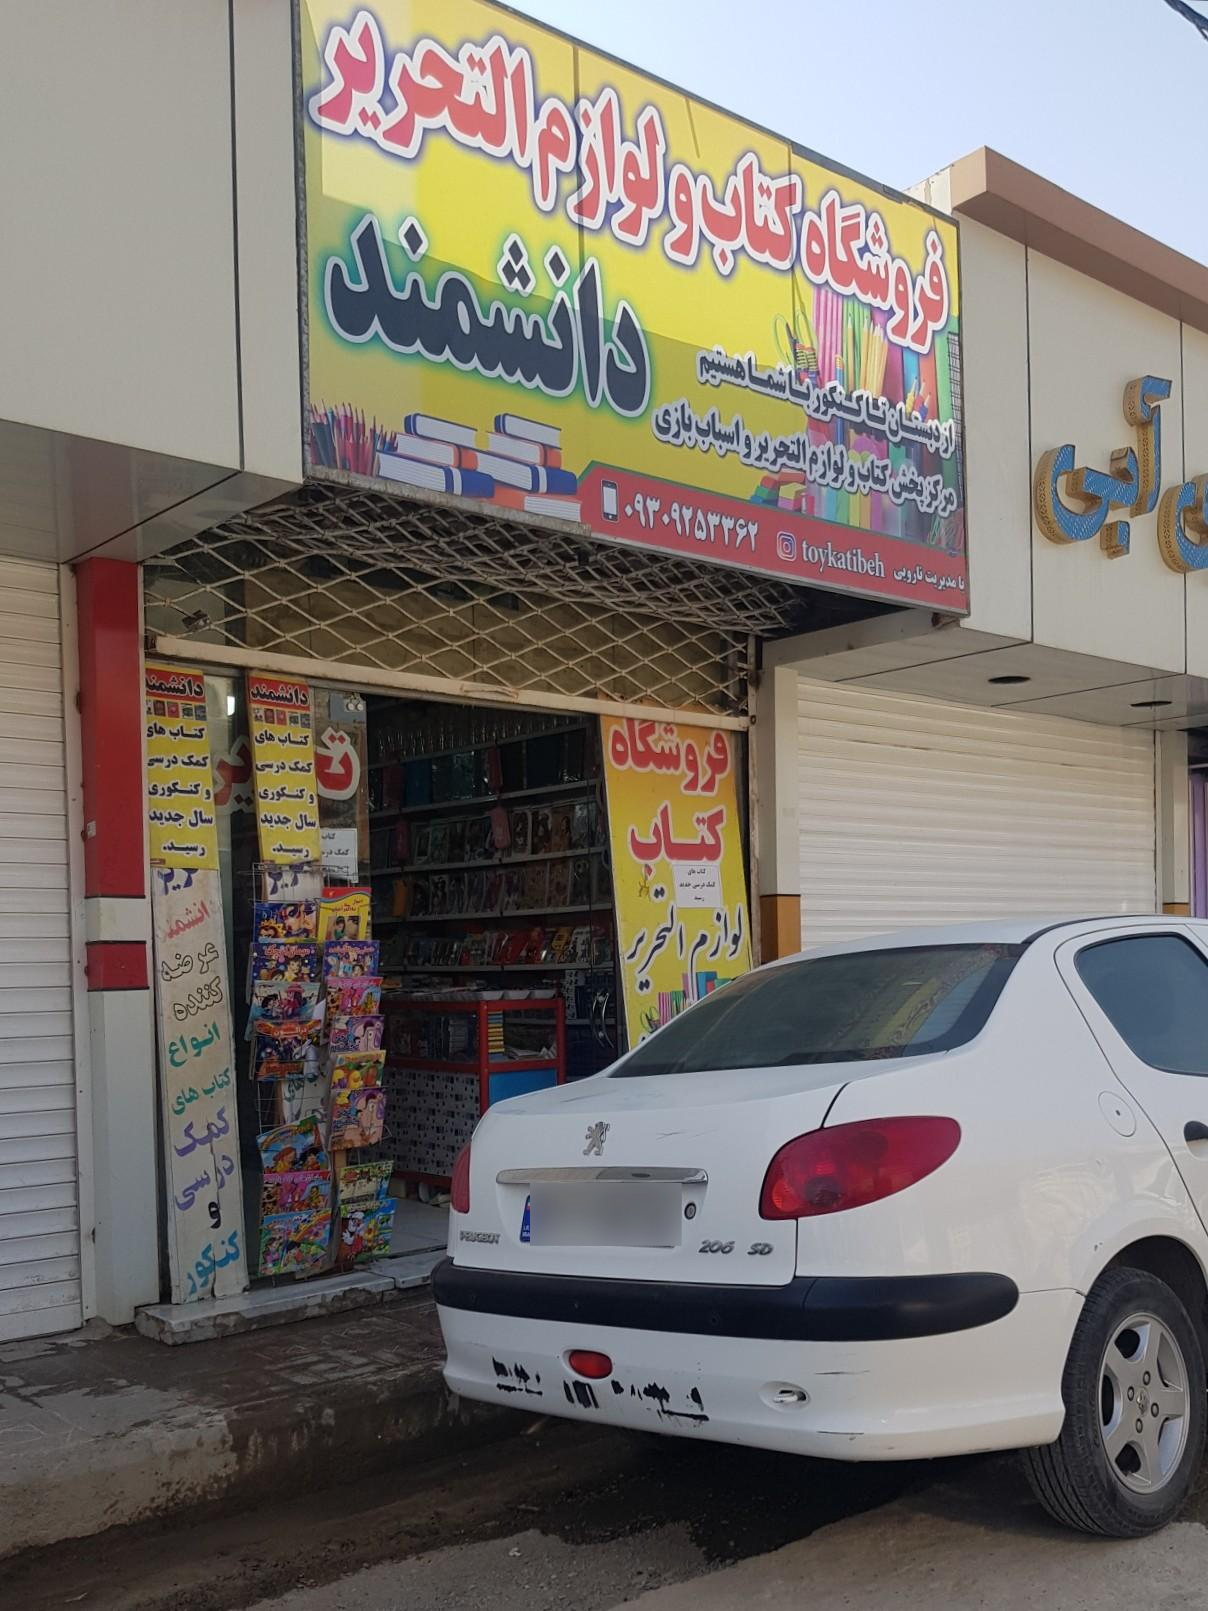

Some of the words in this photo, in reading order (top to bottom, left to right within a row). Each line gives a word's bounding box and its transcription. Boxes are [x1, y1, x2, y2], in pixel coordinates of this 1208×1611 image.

[309, 10, 531, 168] التحریر
[533, 88, 666, 246] لوازم
[664, 164, 698, 265] و
[698, 152, 801, 275] کتاب
[802, 190, 950, 354] فروشگاه
[324, 213, 651, 417] دانشمند
[696, 345, 747, 387] هستیم
[745, 352, 788, 400] شما
[787, 366, 813, 411] با
[652, 398, 696, 447] بازی
[865, 391, 889, 430] تا
[887, 401, 941, 453] دبستان
[695, 408, 743, 457] اسباب
[741, 430, 754, 464] و
[754, 432, 809, 473] التحریر
[939, 419, 955, 459] از
[807, 441, 848, 489] لوازم
[845, 462, 858, 493] و
[857, 454, 892, 496] کتاب
[888, 464, 926, 512] پخش
[926, 474, 957, 517] مرکز
[624, 492, 759, 552] ۰۹۳۰۹۲۵۳۳۶۲
[801, 540, 886, 578] toykatibeh
[924, 571, 957, 590] مدیریت
[250, 683, 309, 706] دانشمند
[146, 721, 166, 739] های
[169, 725, 206, 741] کتاب
[254, 729, 276, 745] های
[277, 732, 310, 748] کتاب
[147, 754, 179, 769] درسی
[181, 754, 210, 768] کمک
[255, 761, 287, 775] درسی
[288, 760, 313, 774] کمک
[610, 718, 730, 797] فروشگاه
[148, 781, 201, 798] کنکوری
[204, 788, 212, 801] و
[259, 786, 306, 801] کنکوری
[308, 793, 315, 805] و
[149, 810, 185, 828] جدید
[188, 809, 214, 828] سال
[260, 813, 292, 830] جدید
[295, 812, 317, 831] سال
[627, 800, 726, 878] کتاب
[625, 885, 685, 993] التحریر
[688, 902, 744, 1002] لوازم
[161, 943, 220, 982] عرضه
[173, 976, 224, 1021] کننده
[168, 1021, 222, 1068] انواع
[171, 1087, 200, 1116] های
[201, 1067, 232, 1098] کتاب
[174, 1106, 230, 1157] کمک
[175, 1155, 235, 1212] درسی
[208, 1201, 222, 1229] و
[186, 1231, 241, 1296] کنکور
[698, 1240, 736, 1255] 206
[747, 1242, 774, 1256] SD
